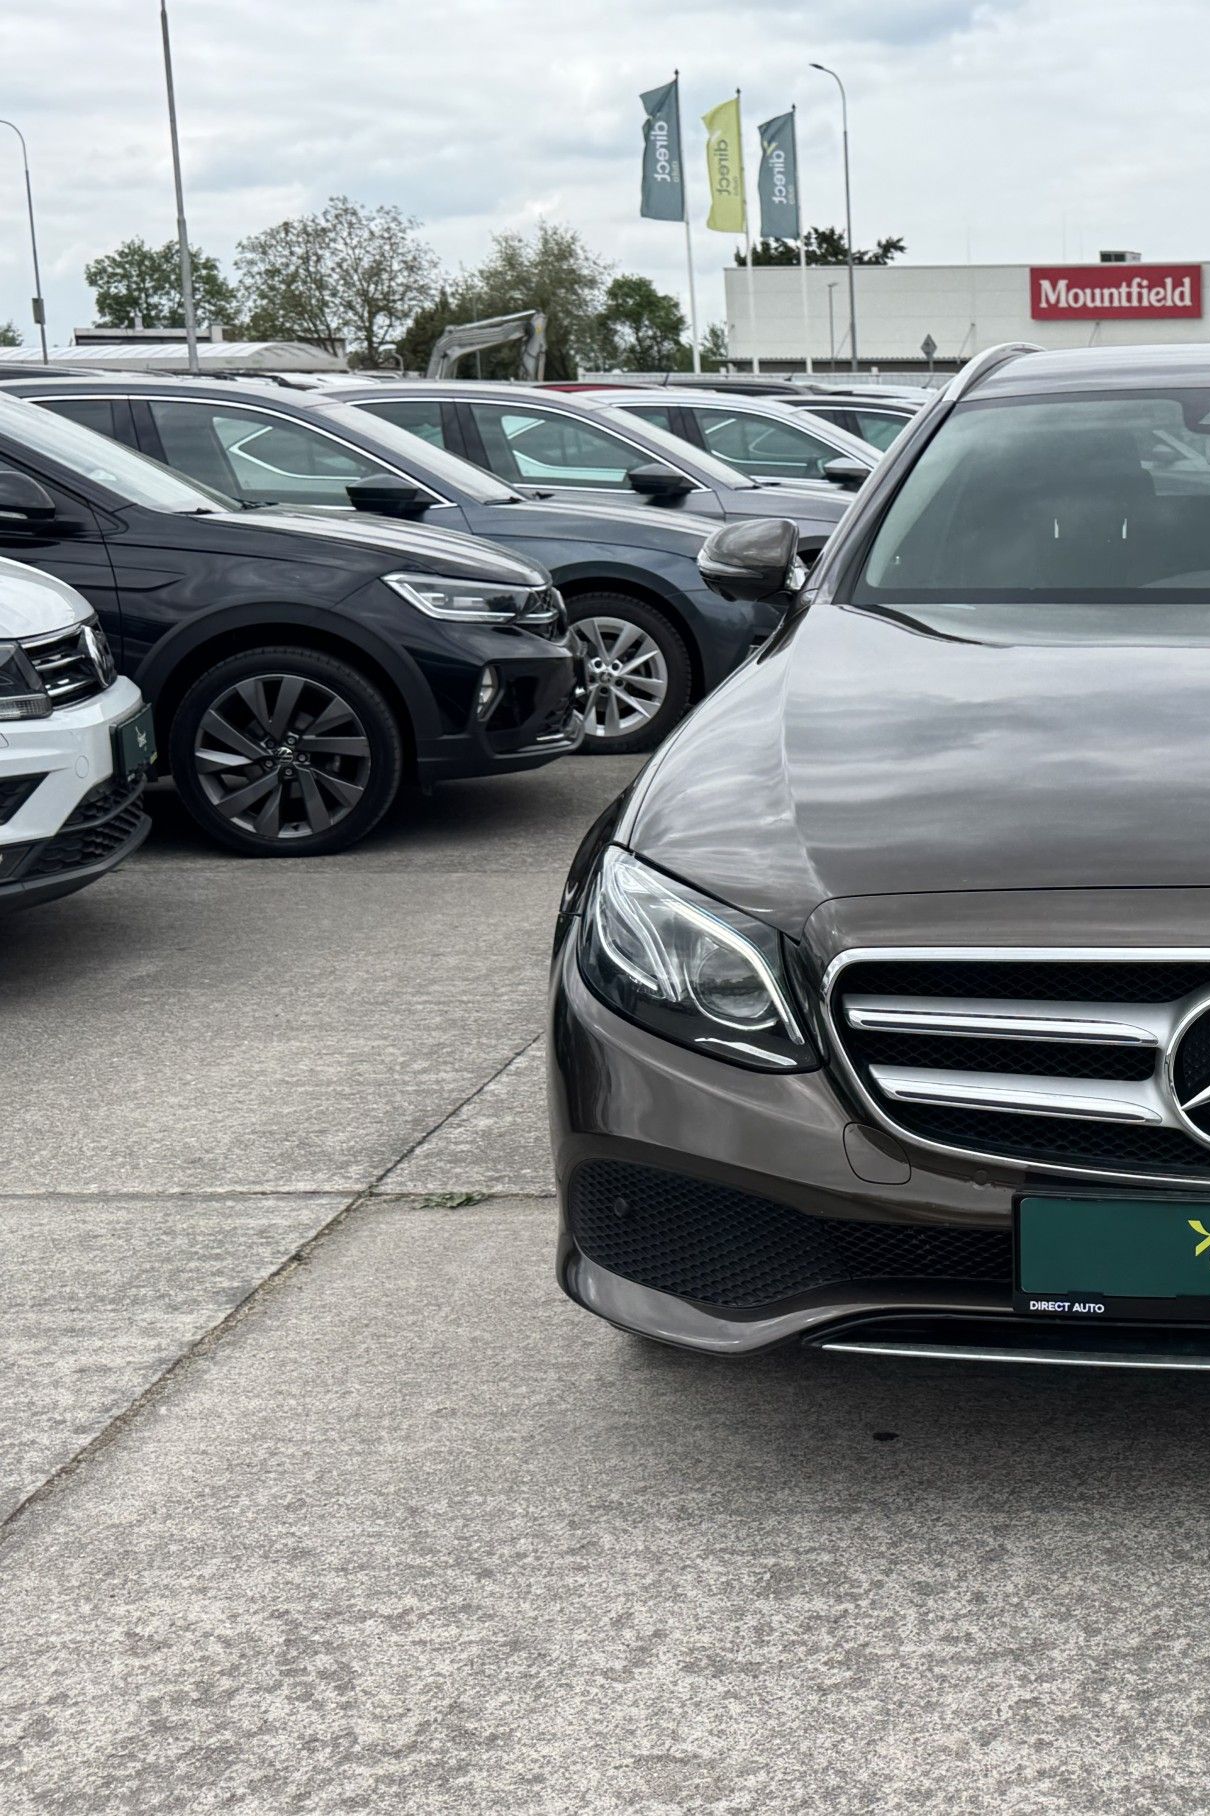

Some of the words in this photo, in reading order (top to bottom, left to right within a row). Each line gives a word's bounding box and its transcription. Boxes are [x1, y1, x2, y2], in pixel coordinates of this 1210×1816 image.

[1039, 277, 1192, 308] Mountfield
[1029, 1300, 1071, 1312] DIRECT
[1072, 1302, 1105, 1313] AUTO
